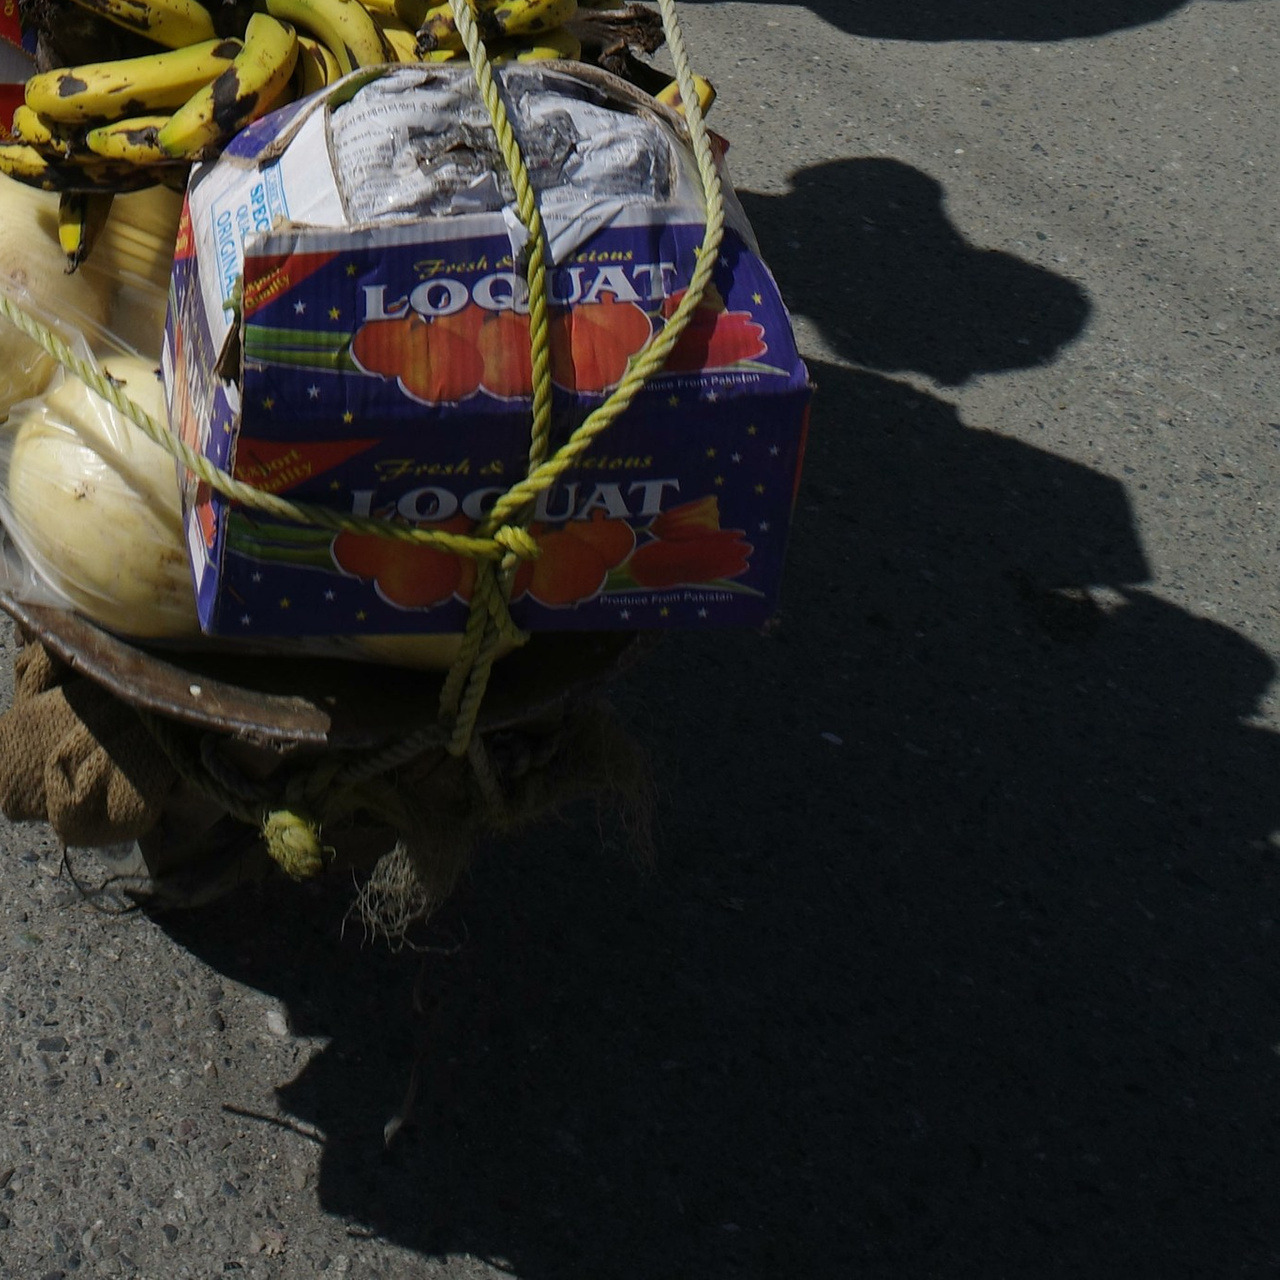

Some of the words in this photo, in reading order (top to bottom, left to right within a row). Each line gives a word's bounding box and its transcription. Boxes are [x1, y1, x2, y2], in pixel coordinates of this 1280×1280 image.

[413, 253, 489, 280] Fresh
[362, 261, 678, 322] LOQUAT
[677, 377, 708, 389] From
[710, 372, 761, 388] Pakistan
[375, 456, 470, 481] Fresh
[481, 459, 506, 475] &
[599, 594, 648, 606] Produce
[650, 592, 681, 604] From
[684, 590, 734, 603] Pakistan
